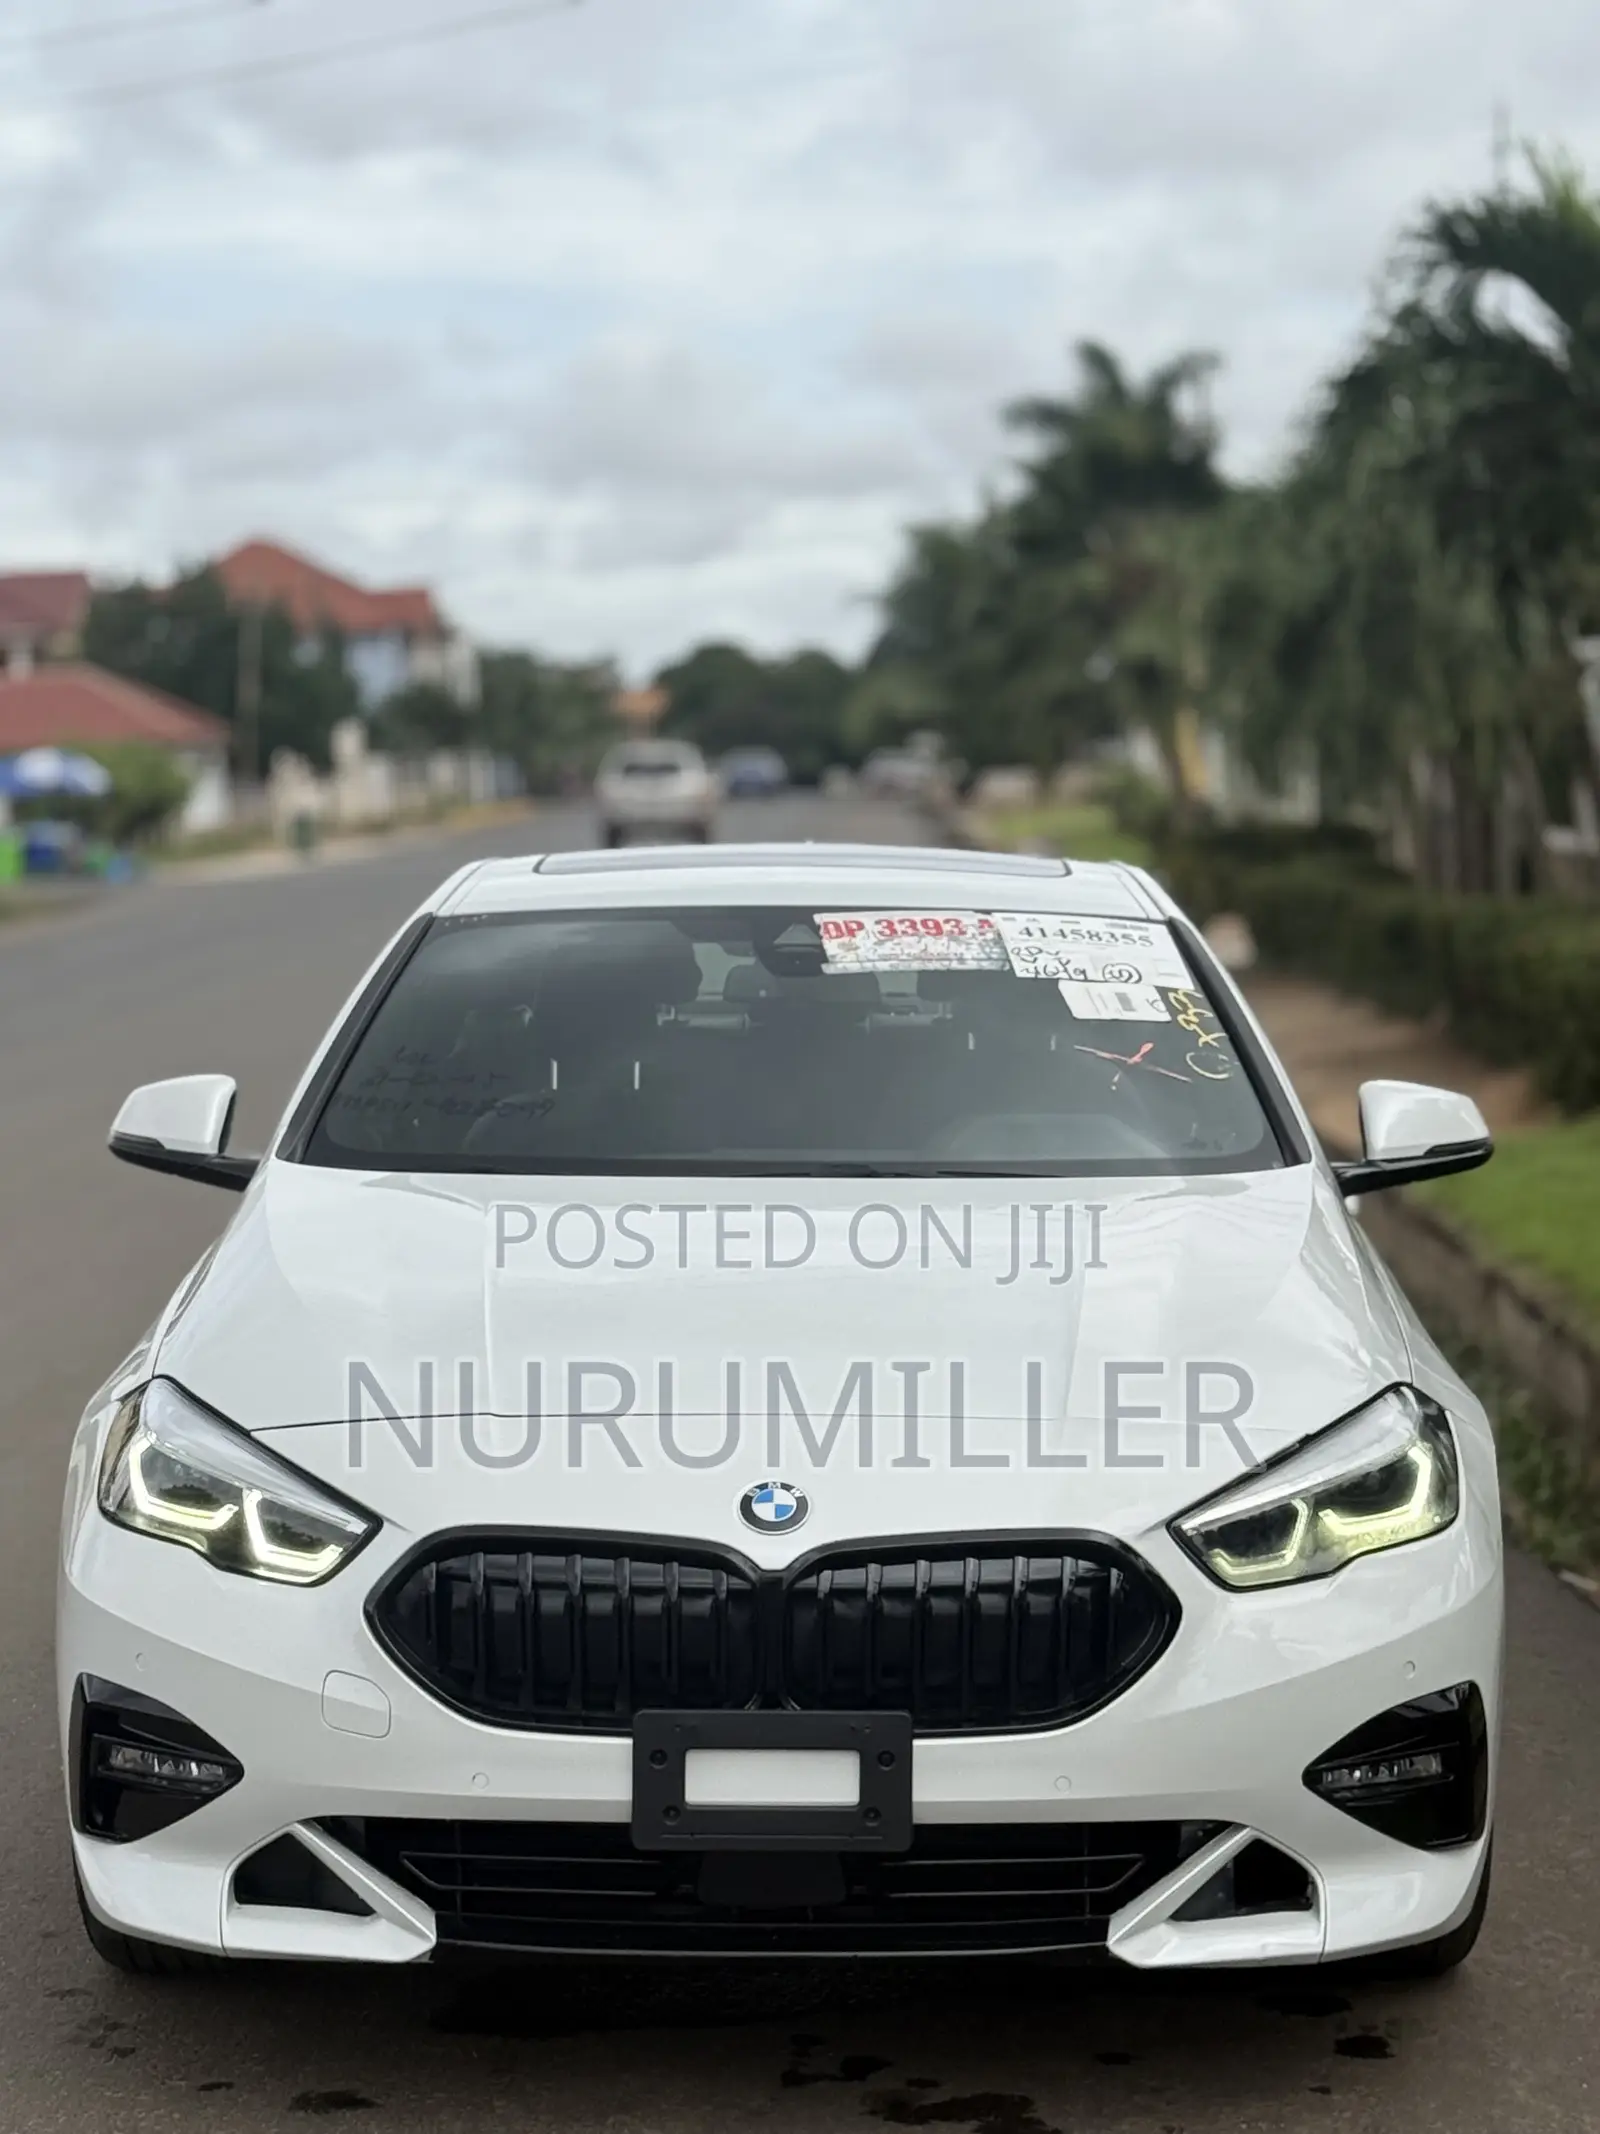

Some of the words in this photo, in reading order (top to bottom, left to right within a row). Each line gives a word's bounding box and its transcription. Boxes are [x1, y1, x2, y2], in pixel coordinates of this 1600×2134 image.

[822, 919, 865, 940] DP
[875, 918, 967, 937] 3393
[1018, 926, 1154, 947] 41458355
[746, 1482, 804, 1498] BMW
